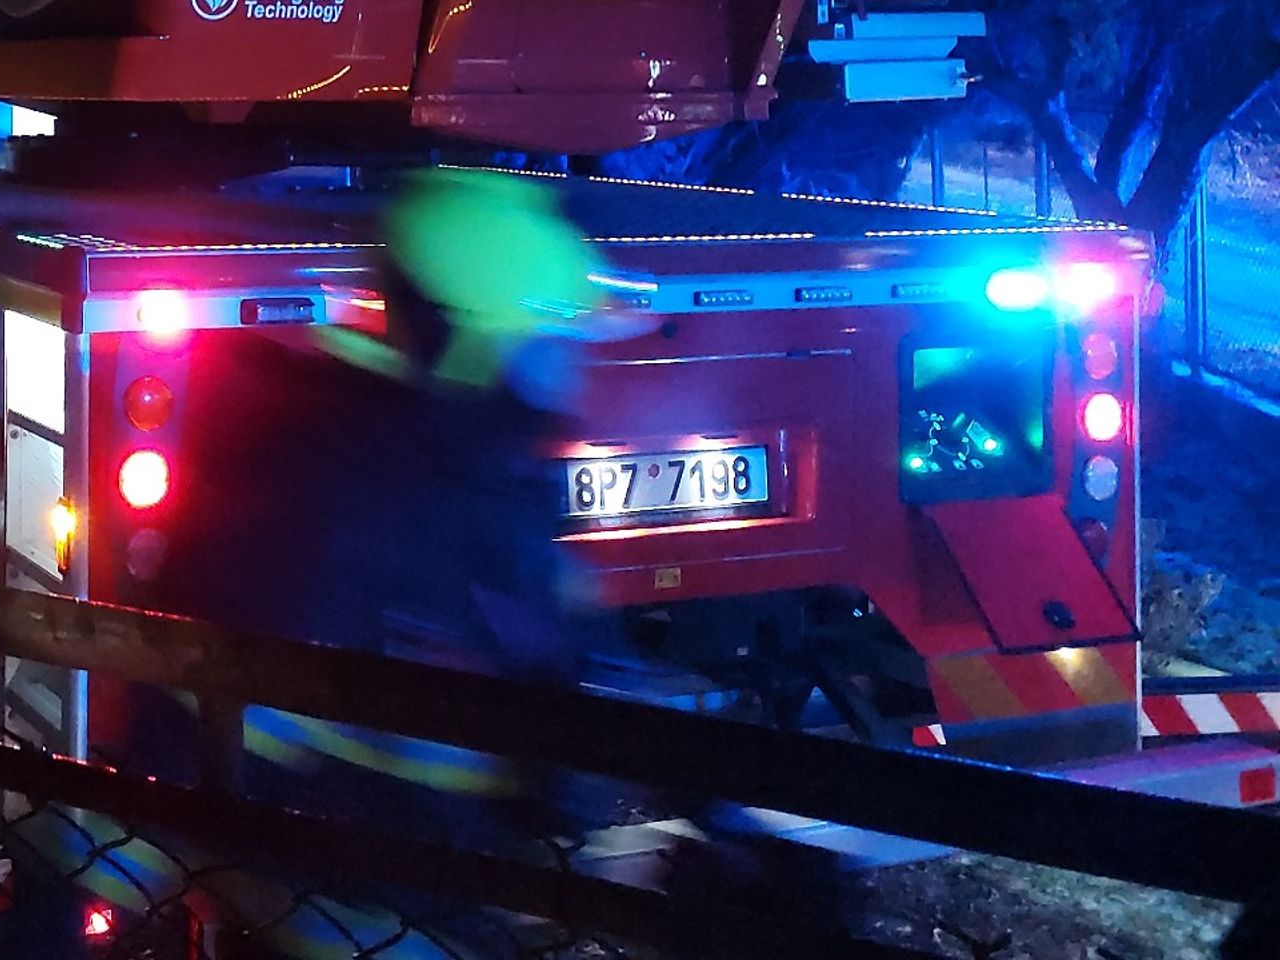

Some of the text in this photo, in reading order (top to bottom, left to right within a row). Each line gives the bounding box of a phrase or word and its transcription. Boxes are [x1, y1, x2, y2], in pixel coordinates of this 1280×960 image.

[245, 1, 343, 23] Technology
[575, 455, 750, 512] 8P7 7198
